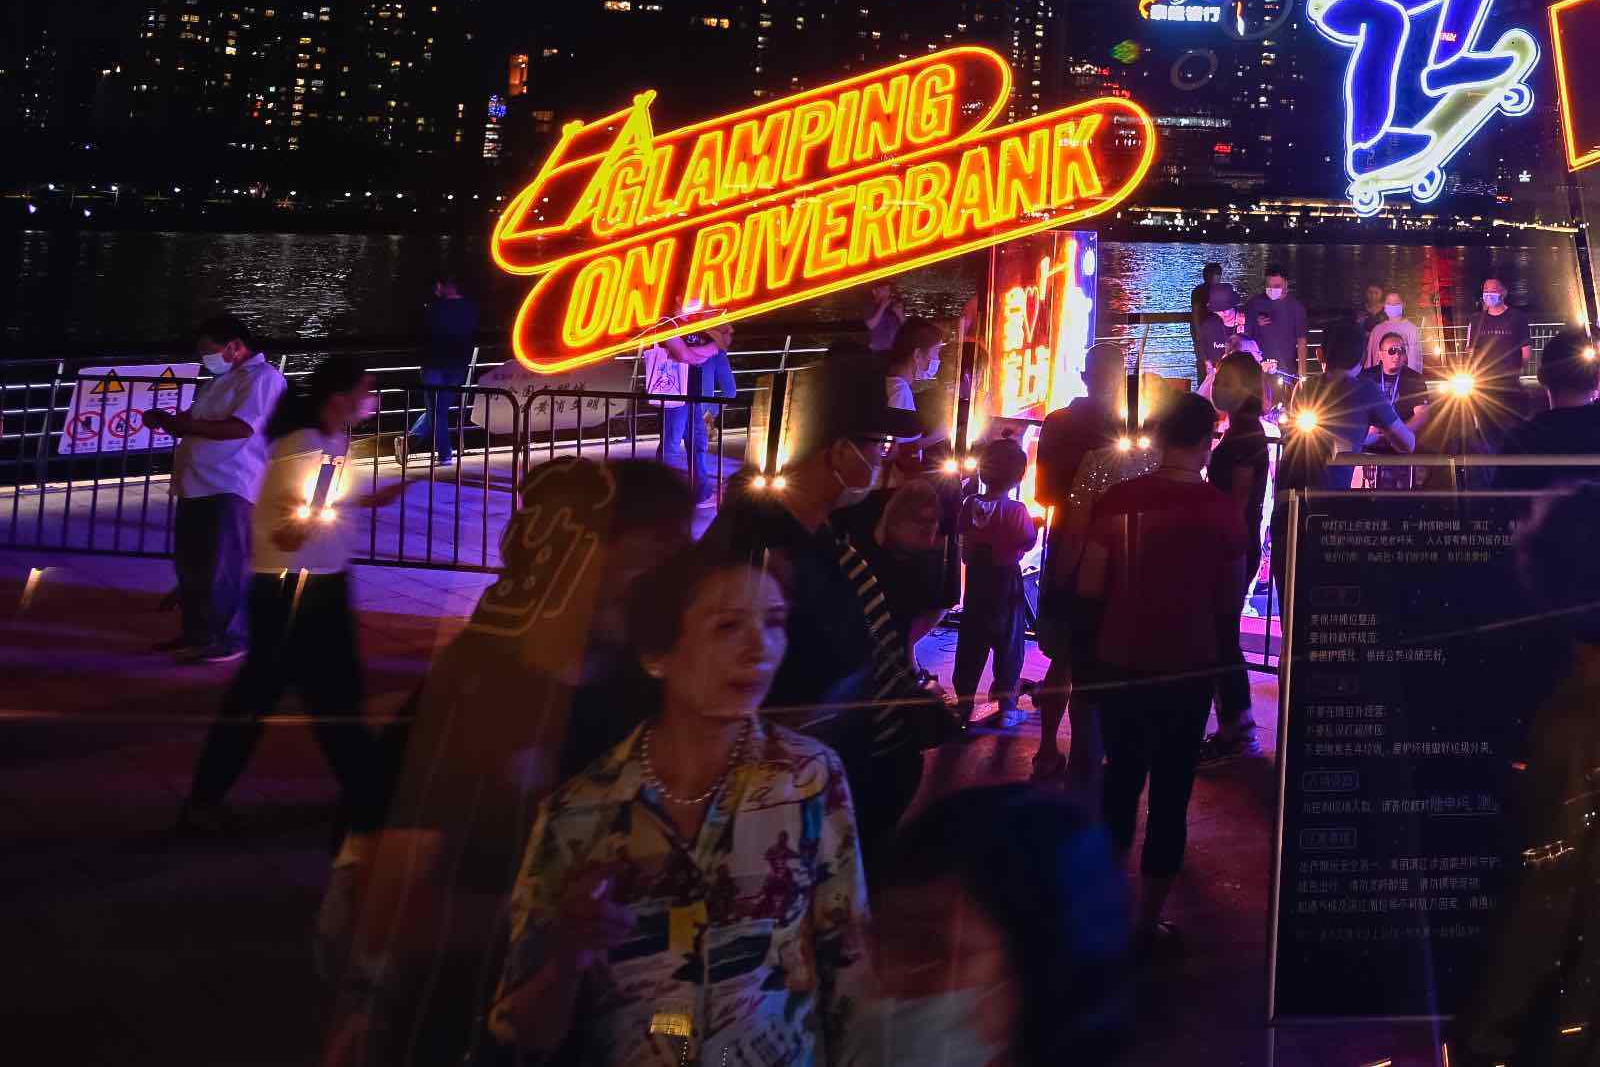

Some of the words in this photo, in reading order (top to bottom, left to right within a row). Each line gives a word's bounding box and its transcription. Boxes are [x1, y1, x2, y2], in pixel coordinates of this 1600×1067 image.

[562, 238, 674, 348] ON
[684, 112, 1104, 310] RIVERBANK
[591, 63, 958, 238] GLAMPING
